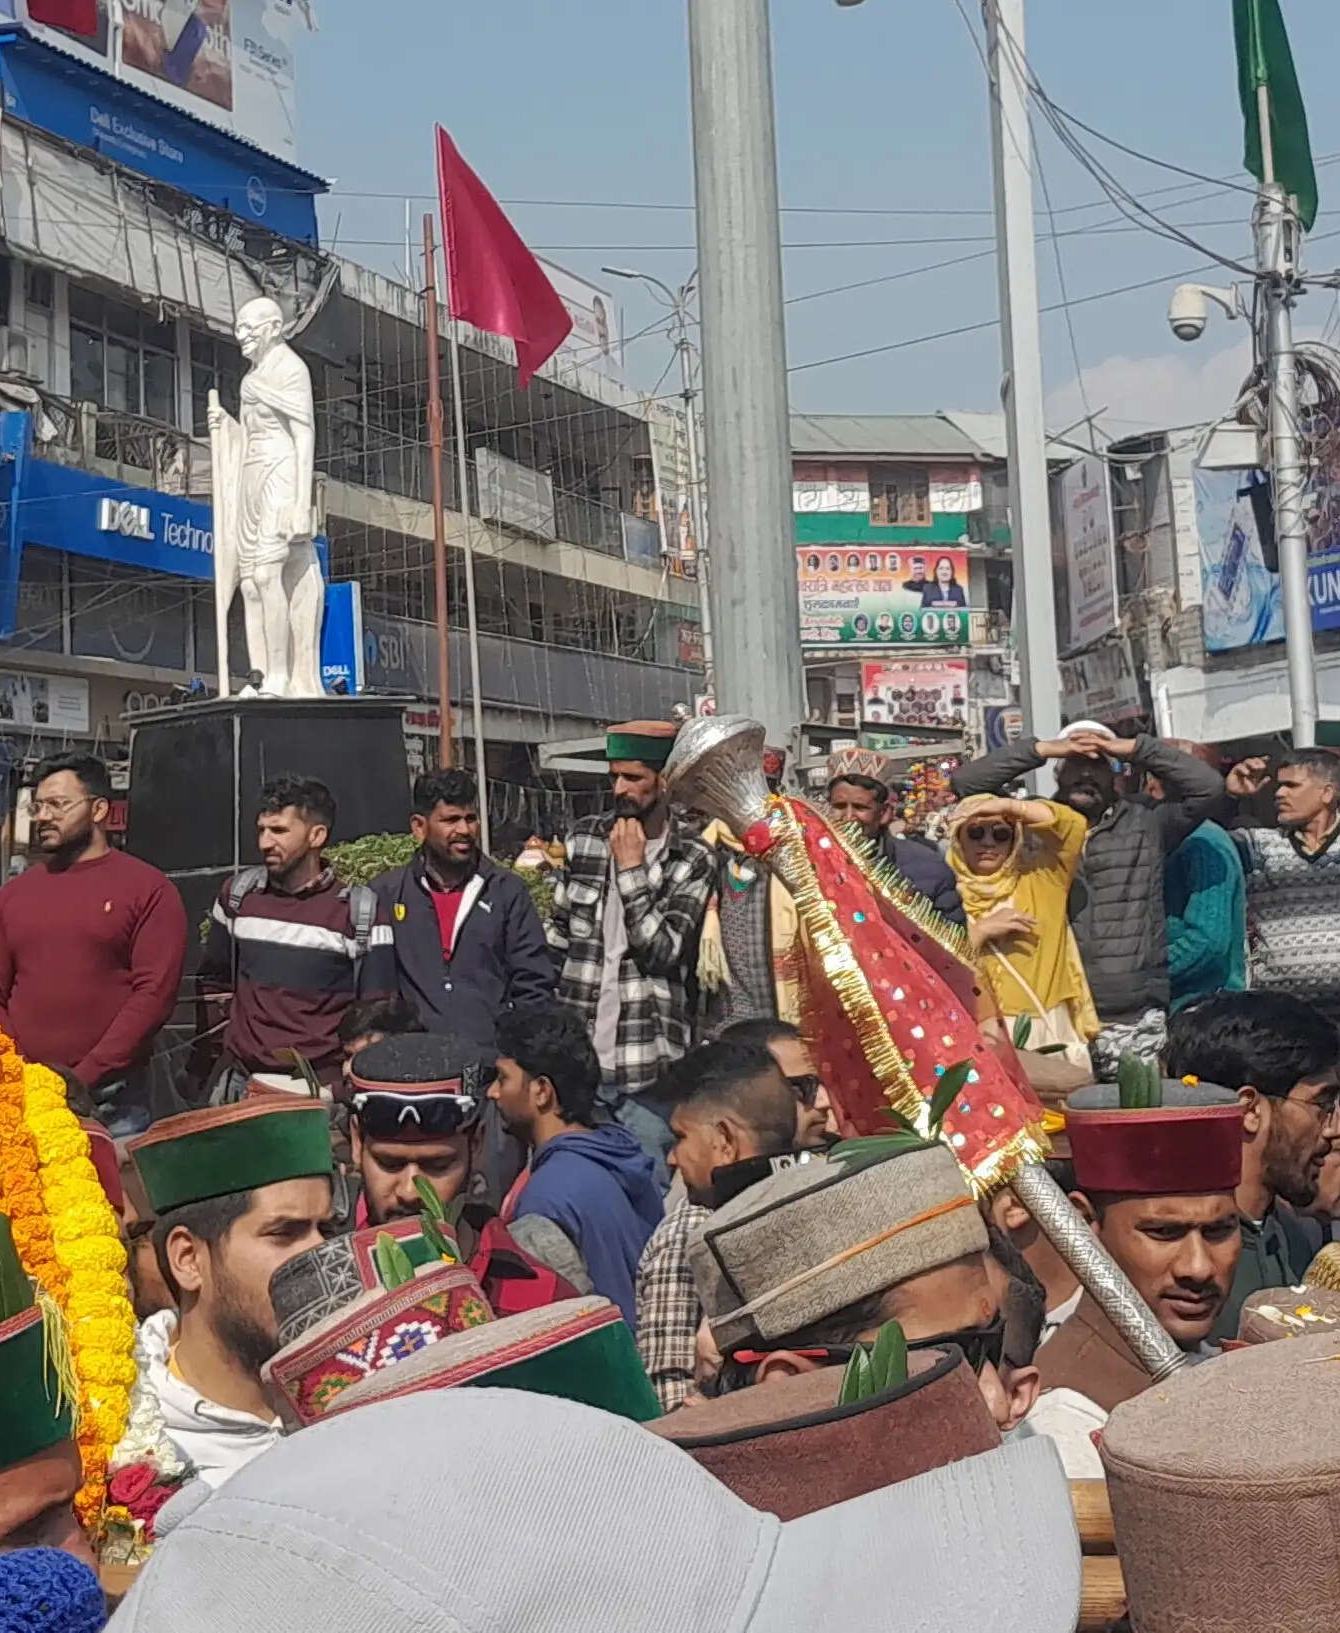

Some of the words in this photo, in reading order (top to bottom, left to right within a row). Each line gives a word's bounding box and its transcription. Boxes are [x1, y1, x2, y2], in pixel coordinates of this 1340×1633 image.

[97, 497, 155, 540] DELL
[379, 633, 405, 670] SBI
[323, 664, 350, 677] DELL
